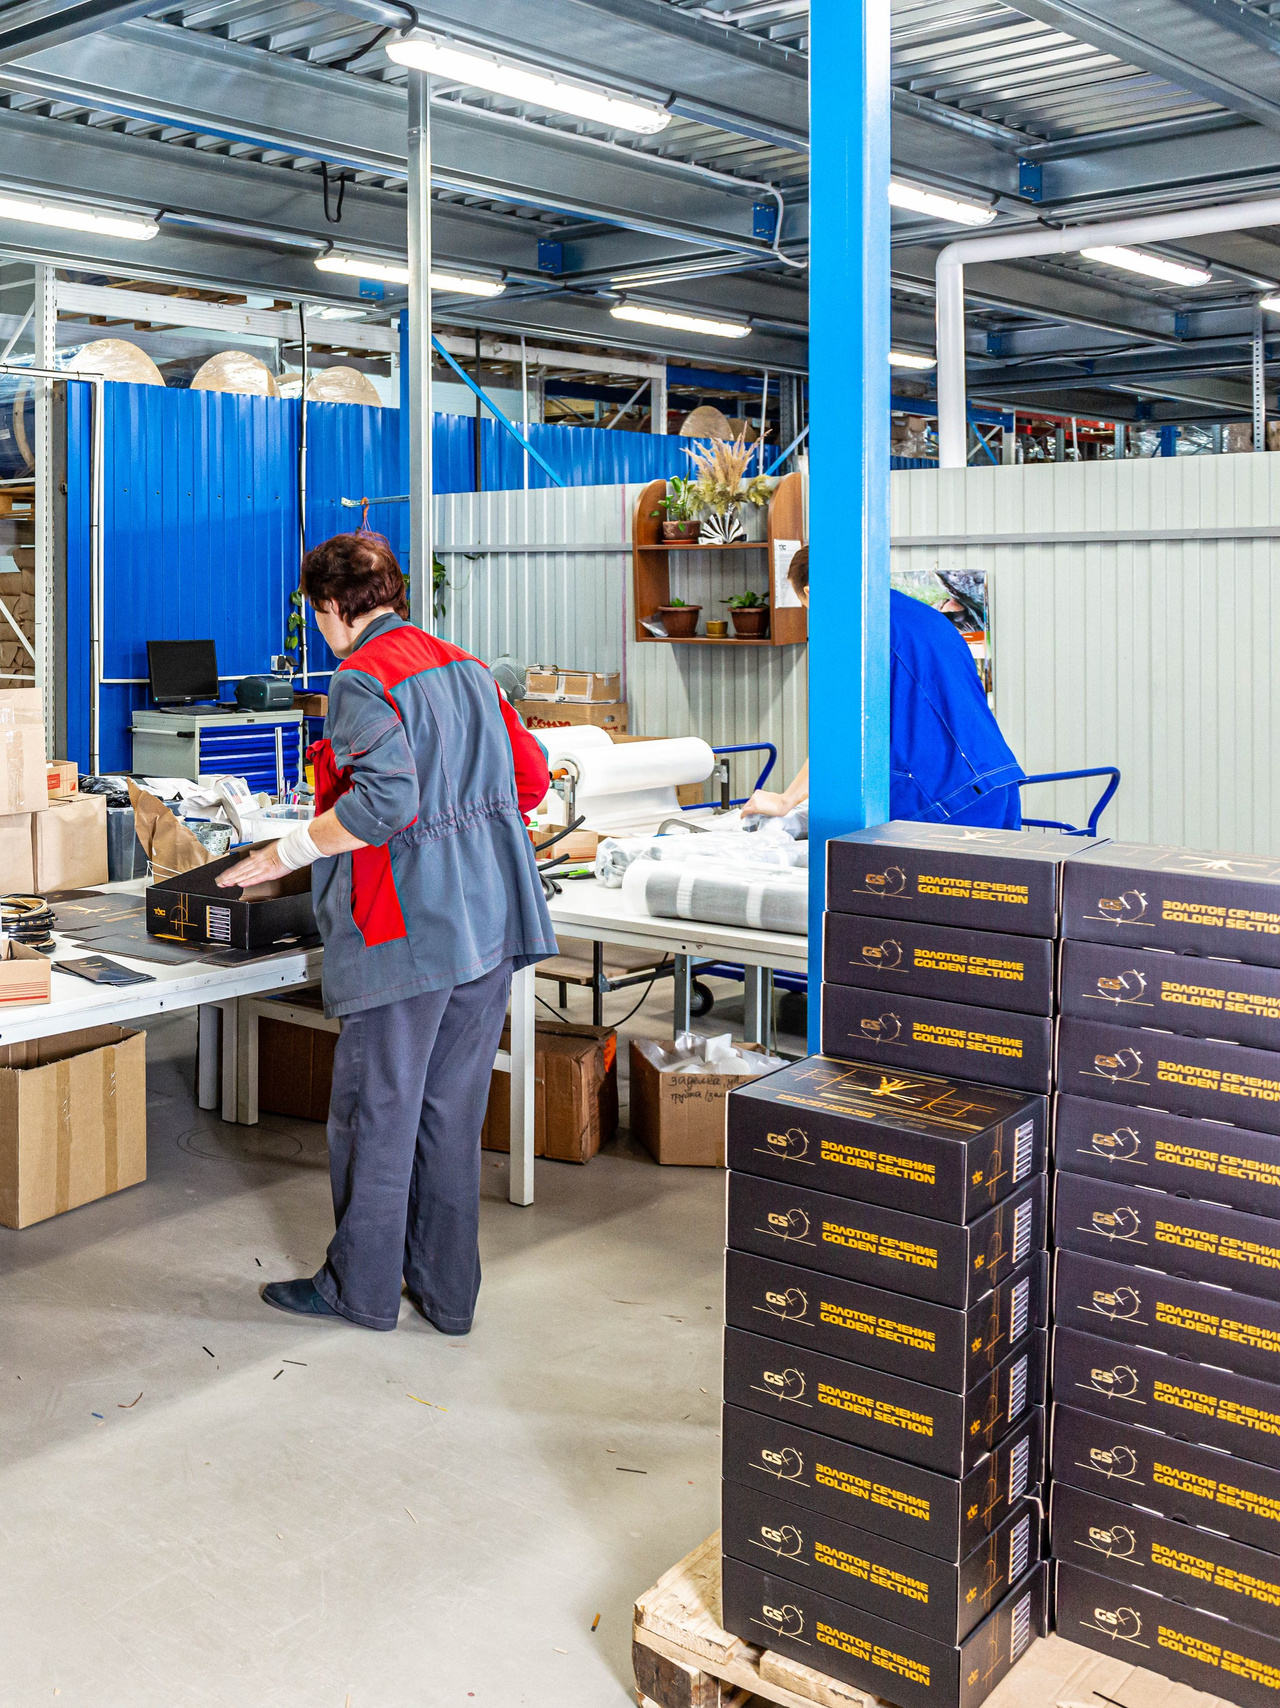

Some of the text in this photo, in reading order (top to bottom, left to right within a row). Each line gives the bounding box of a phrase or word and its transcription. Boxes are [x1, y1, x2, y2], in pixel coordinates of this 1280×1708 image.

[865, 873, 886, 885] GS
[918, 875, 1028, 894] ЗОЛОТОЕ СЕЧЕНИЕ
[918, 884, 1028, 904] GOLDEN SECTION
[1099, 898, 1122, 911] GS
[1162, 910, 1224, 926] GOLDEN
[1163, 901, 1226, 916] ЗОЛОТОЕ
[862, 946, 882, 958] GS
[914, 949, 1024, 971] ЗОЛОТОЕ СЕЧЕНИЕ
[914, 958, 1024, 981] GOLDEN SECTION
[1098, 977, 1121, 989] GS
[1162, 982, 1225, 999] ЗОЛОТОЕ
[1161, 989, 1223, 1009] GOLDEN
[861, 1019, 881, 1031] GS
[913, 1022, 1023, 1048] ЗОЛОТОЕ СЕЧЕНИЕ
[912, 1032, 1023, 1058] GOLDEN SECTION
[1095, 1055, 1118, 1067] GS
[1158, 1061, 1221, 1080] ЗОЛОТОЕ
[1157, 1071, 1218, 1090] GOLDEN
[767, 1133, 787, 1147] GS
[1093, 1133, 1116, 1146] GS
[821, 1140, 935, 1174] ЗОЛОТОЕ СЕЧЕНИЕ
[1155, 1151, 1216, 1172] GOLDEN
[1156, 1141, 1219, 1162] ЗОЛОТОЕ
[821, 1150, 935, 1185] GOLDEN SECTION
[768, 1213, 788, 1227] GS
[1093, 1211, 1116, 1226] GS
[822, 1222, 938, 1258] ЗОЛОТОЕ СЕЧЕНИЕ
[1155, 1231, 1216, 1253] GOLDEN
[1156, 1221, 1219, 1243] ЗОЛОТОЕ
[822, 1232, 937, 1269] GOLDEN SECTION
[766, 1291, 786, 1306] GS
[1093, 1290, 1116, 1305] GS
[820, 1302, 935, 1341] ЗОЛОТОЕ СЕЧЕНИЕ
[1156, 1302, 1220, 1325] ЗОЛОТОЕ
[1156, 1311, 1217, 1335] GOLDEN
[820, 1312, 935, 1352] GOLDEN SECTION
[763, 1371, 784, 1386] GS
[1091, 1369, 1114, 1384] GS
[1153, 1391, 1215, 1416] GOLDEN
[1154, 1381, 1218, 1406] ЗОЛОТОЕ
[818, 1383, 933, 1426] ЗОЛОТОЕ СЕЧЕНИЕ
[818, 1393, 933, 1437] GOLDEN SECTION
[761, 1450, 782, 1466] GS
[1090, 1448, 1112, 1464] GS
[816, 1463, 930, 1510] ЗОЛОТОЕ СЕЧЕНИЕ
[1153, 1472, 1214, 1500] GOLDEN
[1154, 1462, 1217, 1490] ЗОЛОТОЕ
[815, 1473, 930, 1521] GOLDEN SECTION
[761, 1526, 781, 1543] GS
[1089, 1527, 1111, 1543] GS
[815, 1542, 928, 1592] ЗОЛОТОЕ СЕЧЕНИЕ
[1151, 1551, 1213, 1582] GOLDEN
[1152, 1543, 1215, 1572] ЗОЛОТОЕ
[815, 1552, 928, 1603] GOLDEN SECTION
[762, 1605, 782, 1622] GS
[1094, 1607, 1118, 1625] GS
[816, 1622, 930, 1675] ЗОЛОТОЕ СЕЧЕНИЕ
[1157, 1635, 1219, 1666] GOLDEN
[1158, 1625, 1222, 1657] ЗОЛОТОЕ
[816, 1632, 930, 1686] GOLDEN SECTION
